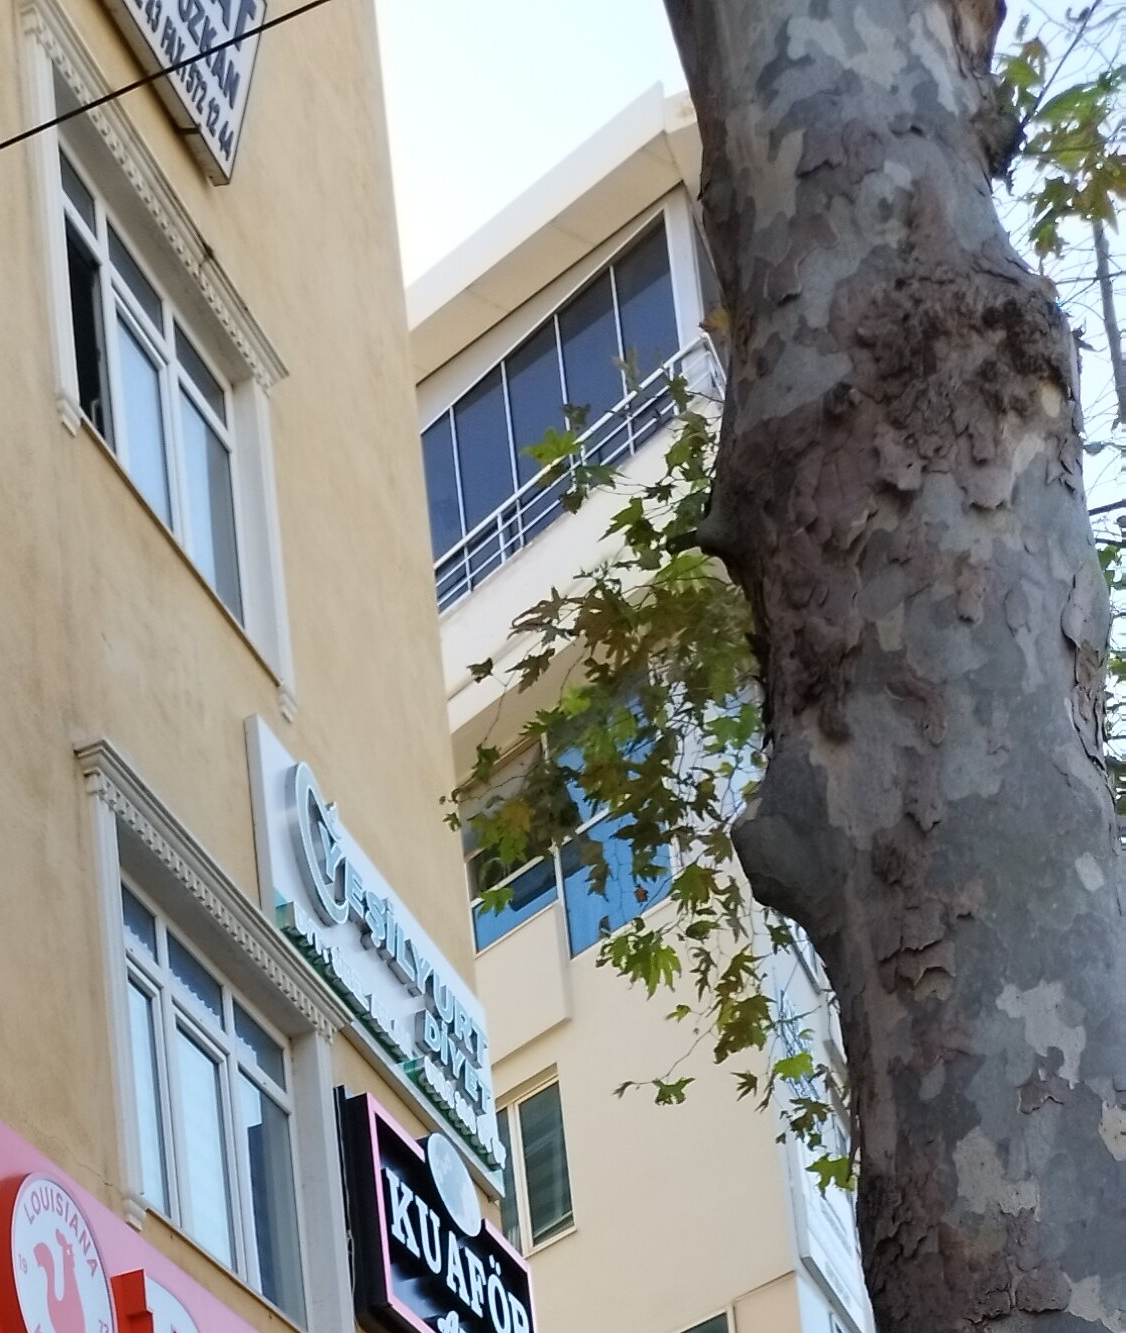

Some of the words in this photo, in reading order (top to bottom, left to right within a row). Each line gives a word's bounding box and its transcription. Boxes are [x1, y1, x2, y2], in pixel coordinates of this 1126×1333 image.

[317, 820, 489, 1067] YEŞİLYURT
[425, 1009, 491, 1115] DİYET
[24, 1187, 99, 1277] LOUISIANA
